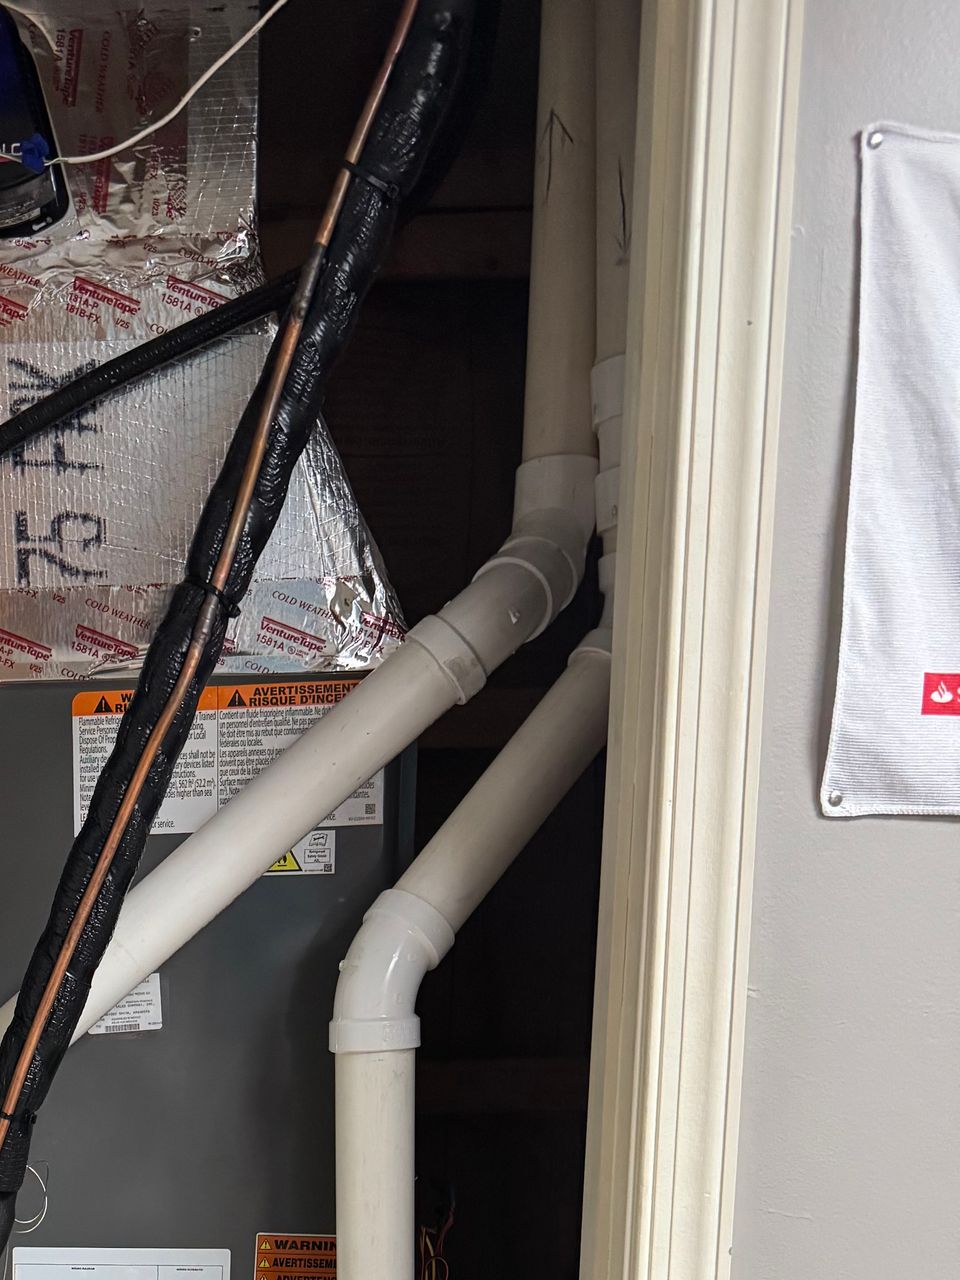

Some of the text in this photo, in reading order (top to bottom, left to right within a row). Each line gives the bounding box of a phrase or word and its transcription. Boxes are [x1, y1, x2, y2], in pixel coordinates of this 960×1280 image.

[73, 280, 139, 316] VentureTape
[161, 293, 192, 313] 1581A
[272, 590, 297, 605] COLD
[85, 598, 110, 613] COLD
[256, 634, 285, 652] 1581A
[260, 621, 325, 653] VentureTape
[71, 641, 99, 659] 1581A
[249, 695, 296, 706] RISQUE
[199, 711, 216, 720] Trained
[79, 726, 118, 735] Service Personne
[79, 736, 98, 745] Dispose
[188, 750, 199, 759] shall
[201, 760, 214, 768] listed
[192, 788, 204, 797] than
[275, 1239, 337, 1251] WARNIN
[272, 1257, 337, 1269] AVERTISSEM
